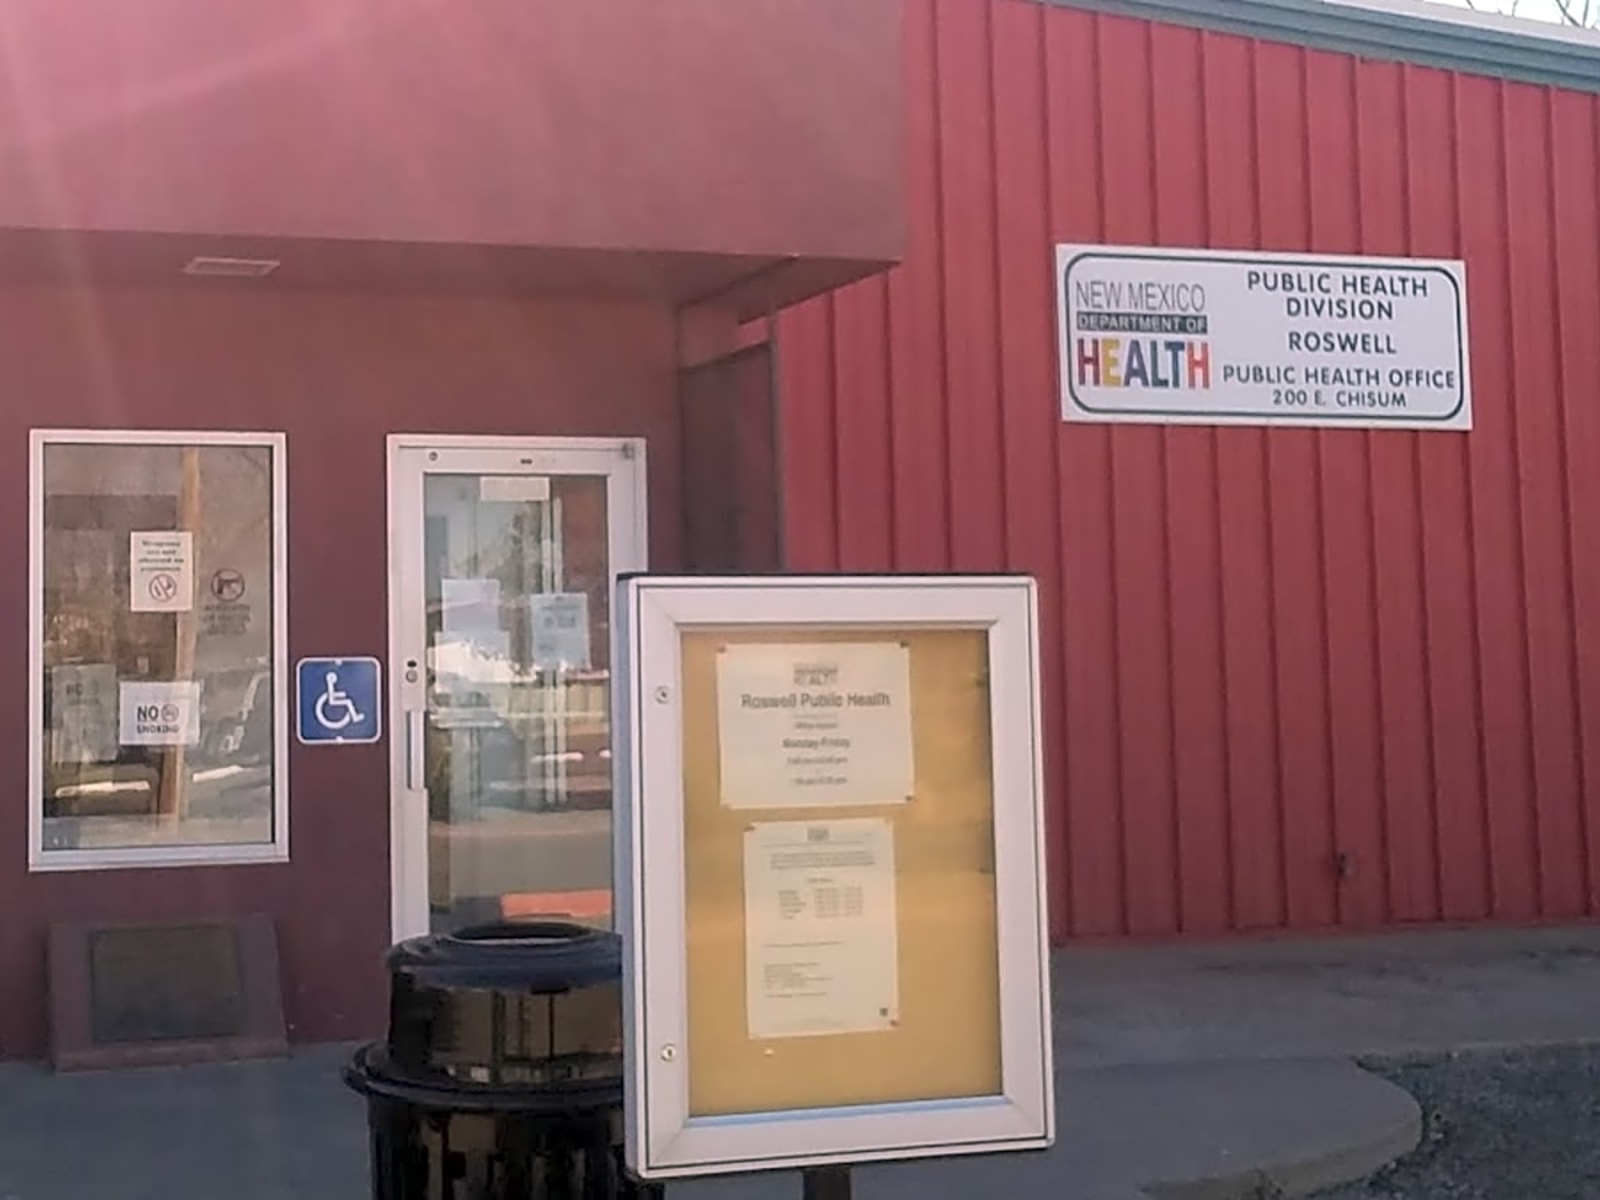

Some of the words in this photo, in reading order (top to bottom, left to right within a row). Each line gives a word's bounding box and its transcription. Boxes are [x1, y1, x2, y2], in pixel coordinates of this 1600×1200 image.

[1248, 270, 1331, 294] PUBLIC
[1342, 275, 1428, 298] HEALTH
[1076, 280, 1122, 309] NEW
[1128, 282, 1205, 312] MEXICO
[1286, 297, 1393, 320] DIVISION
[1078, 313, 1181, 332] DEPARTMENT
[1186, 316, 1206, 332] OF
[1288, 331, 1397, 354] ROSWELL
[1077, 338, 1210, 389] HEALTH
[1223, 364, 1295, 385] PUBLIC
[1305, 367, 1379, 386] HEALTH
[1388, 369, 1455, 389] OFFICE
[1272, 389, 1307, 406] 200
[1314, 391, 1326, 406] E.
[1336, 391, 1407, 408] CHISUM
[741, 692, 796, 709] Roswell
[801, 692, 843, 709] Public
[848, 692, 891, 708] Health
[137, 705, 159, 723] NO
[136, 725, 180, 734] SMOKING
